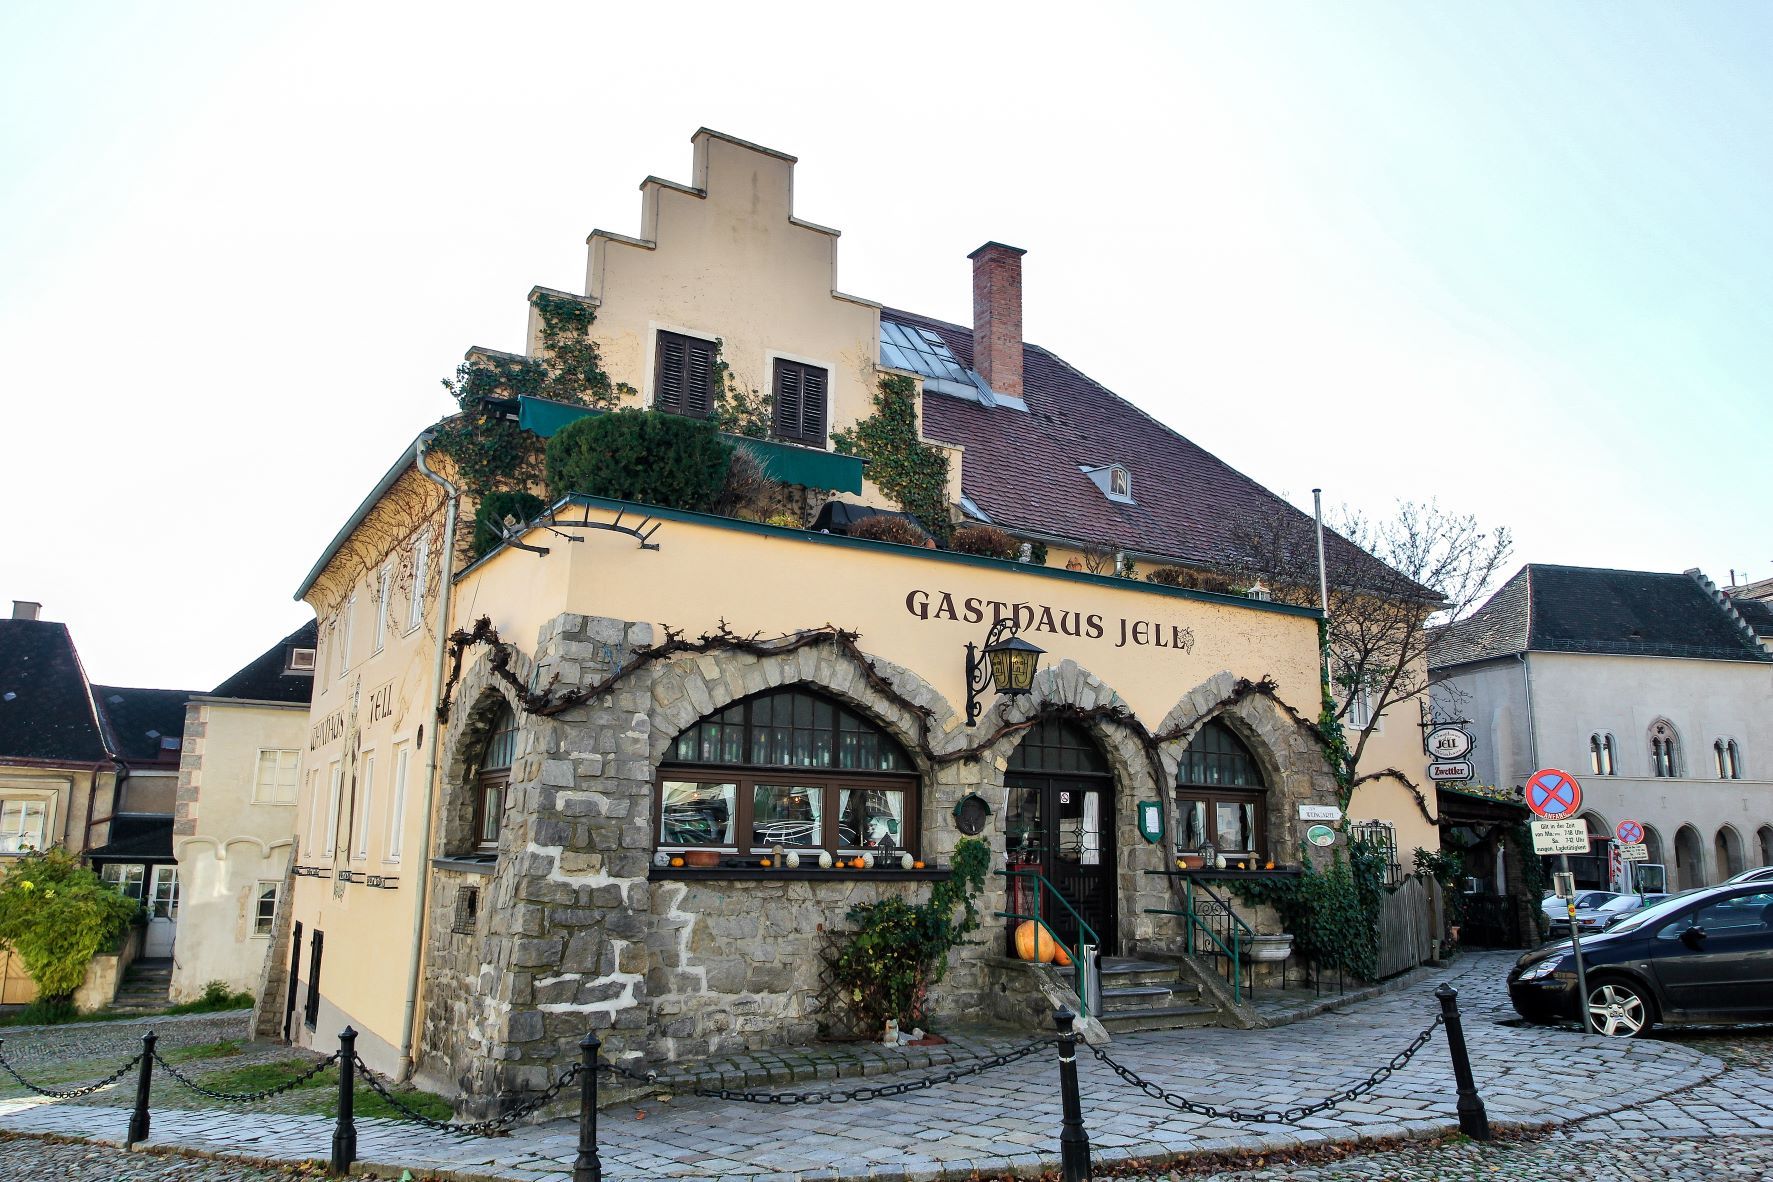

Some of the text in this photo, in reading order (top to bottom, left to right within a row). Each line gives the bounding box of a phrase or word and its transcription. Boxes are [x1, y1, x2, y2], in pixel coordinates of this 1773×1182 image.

[905, 589, 1187, 650] GASTHAUS JELL
[368, 683, 393, 729] JELL
[1434, 766, 1465, 776] Zwettler
[1544, 812, 1567, 820] ANFANG
